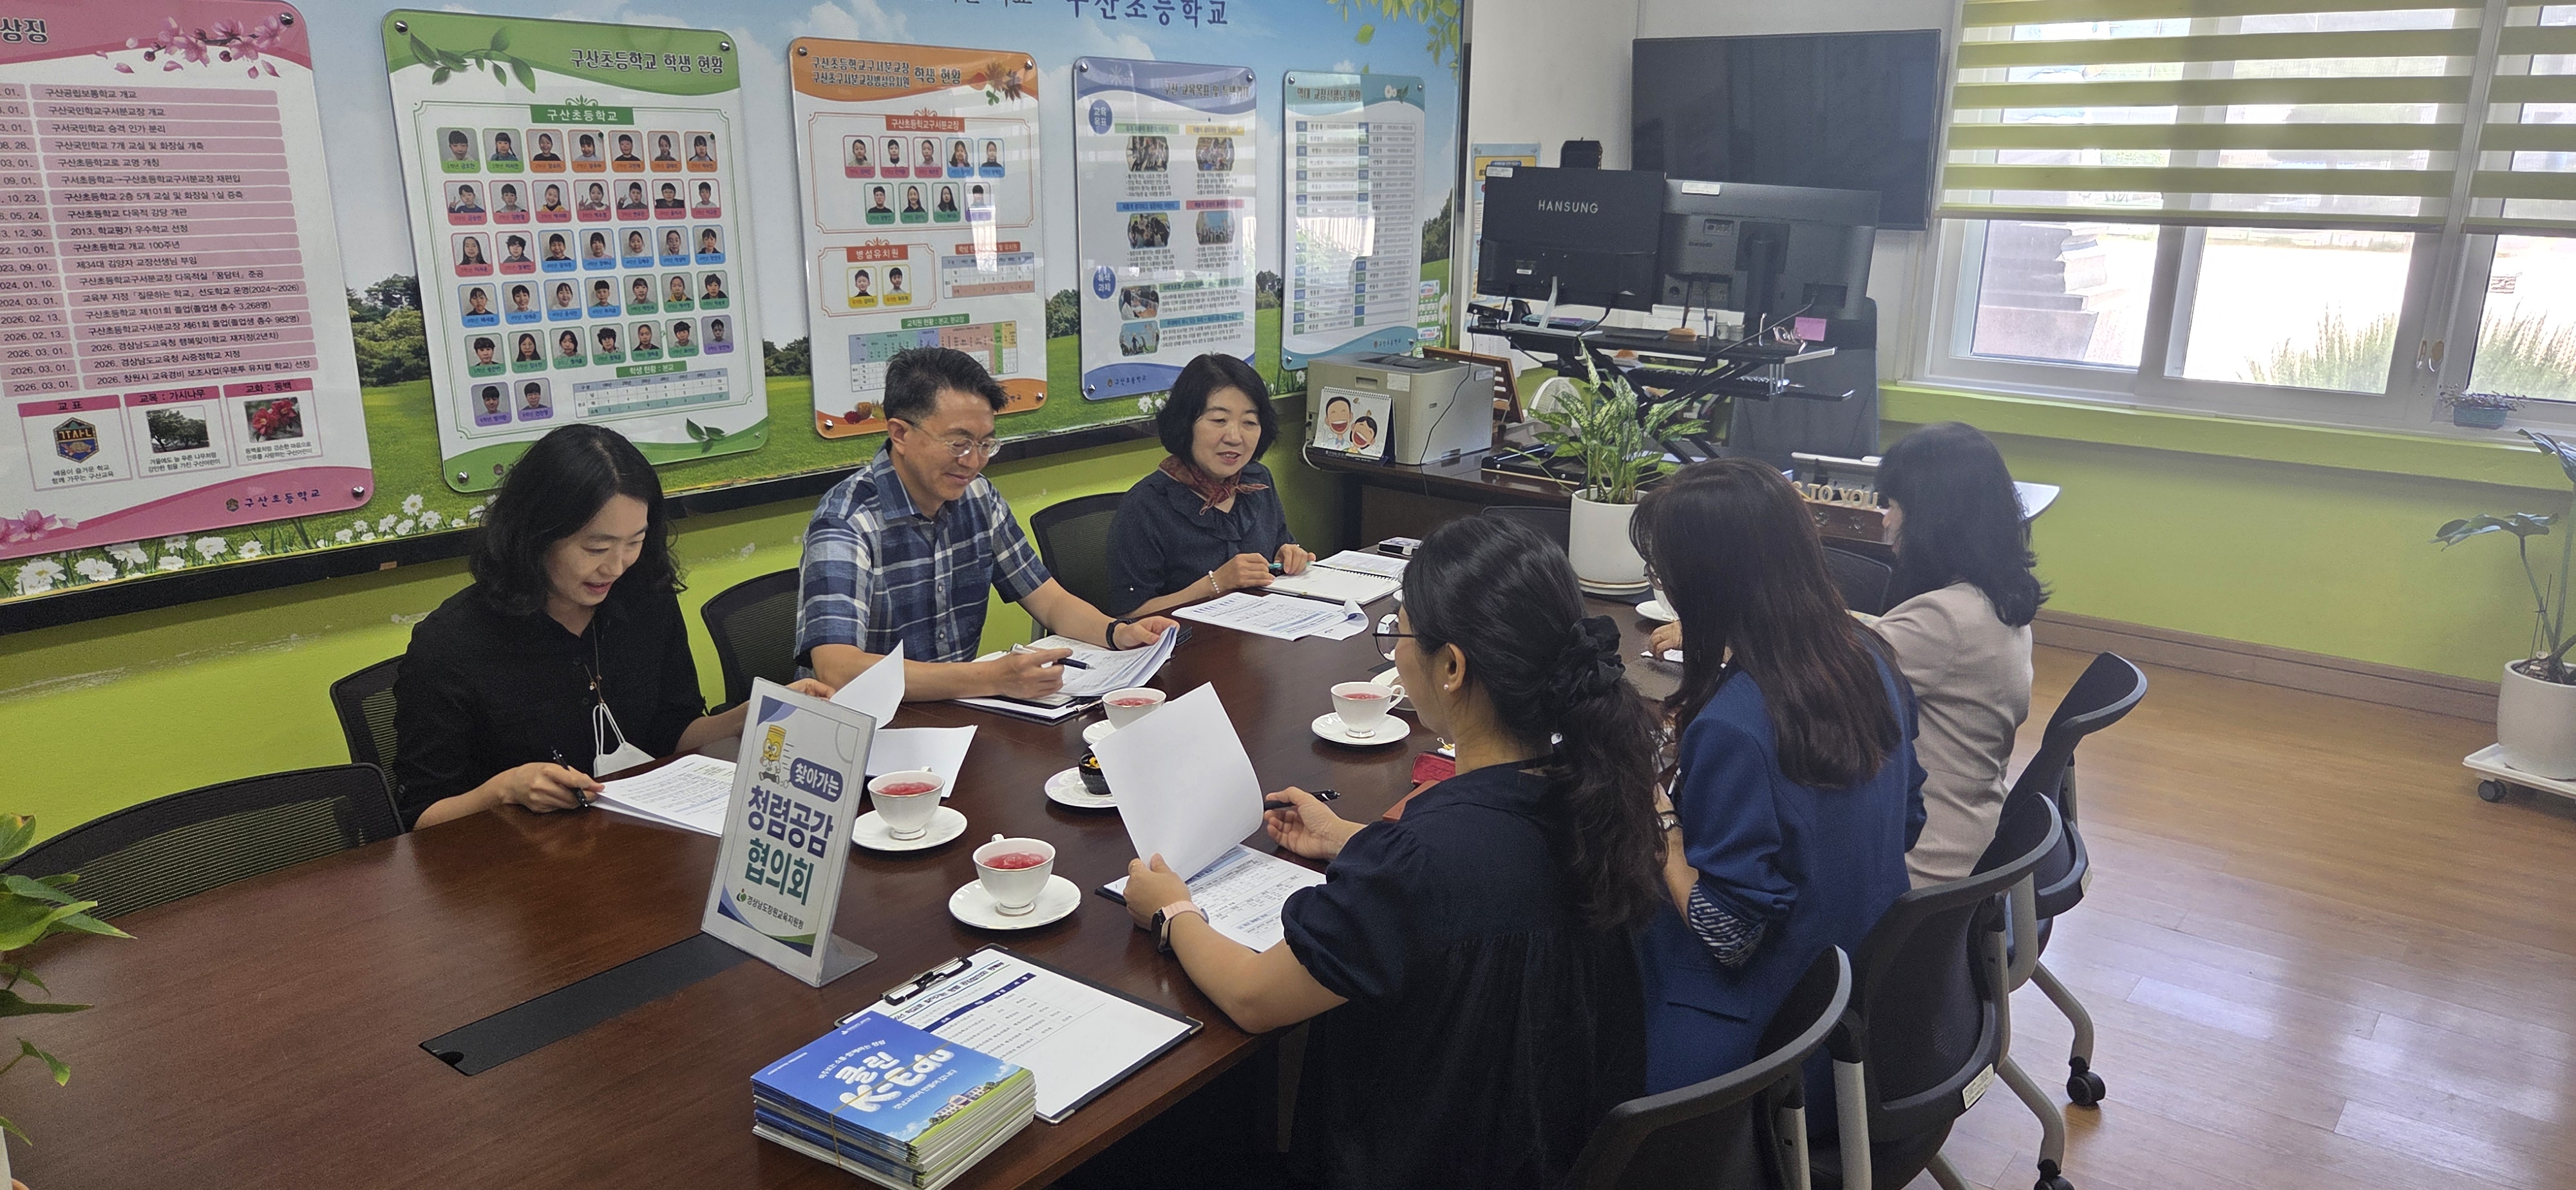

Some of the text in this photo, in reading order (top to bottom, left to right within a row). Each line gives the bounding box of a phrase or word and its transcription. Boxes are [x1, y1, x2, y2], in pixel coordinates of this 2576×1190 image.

[571, 50, 723, 74] 구산초등학교 학생 현황
[914, 67, 961, 84] 학생 현황
[120, 91, 137, 99] 개교
[547, 109, 618, 122] 구산초등학교
[108, 124, 126, 133] 승격
[128, 125, 146, 133] 인가
[149, 125, 166, 133] 분리
[15, 142, 30, 150] 28.
[111, 141, 125, 149] 7개
[160, 142, 184, 150] 화장실
[18, 159, 33, 167] 01.
[21, 176, 36, 185] 01.
[216, 175, 241, 183] 재편입
[8, 194, 22, 203] 10.
[24, 194, 39, 203] 23.
[64, 193, 117, 201] 구산초등학교
[153, 192, 170, 200] 교실
[184, 191, 209, 200] 화장실
[10, 212, 25, 220] 05.
[67, 210, 120, 219] 구산초등학교
[123, 209, 148, 217] 다목적
[171, 208, 187, 216] 개관
[1538, 200, 1598, 214] HANSUNG
[14, 229, 28, 238] 12.
[98, 226, 131, 236] 학교평가
[135, 225, 169, 234] 우수학교
[172, 225, 188, 233] 선정
[73, 243, 126, 252] 구산초등학교
[149, 240, 180, 249] 100주년
[856, 249, 899, 259] 병설유치원
[137, 256, 178, 267] 교장선생님
[180, 256, 197, 265] 부임
[41, 279, 55, 288] 10.
[175, 272, 207, 281] 다목적실
[249, 270, 263, 278] 준공
[82, 294, 108, 303] 교육부
[112, 293, 129, 301] 지정
[198, 287, 231, 296] 선도학교
[2, 316, 26, 324] 2026.
[84, 309, 137, 319] 구산초등학교
[140, 306, 171, 316] 제101회
[5, 332, 30, 341] 2026.
[50, 330, 64, 339] 13.
[88, 324, 180, 335] 구산초등학교구서분교장
[184, 321, 209, 330] 제61회
[7, 350, 33, 358] 2026.
[91, 344, 115, 352] 2026.
[118, 338, 176, 350] 경상남도교육청
[230, 331, 279, 343] 재지정(2년차)
[10, 367, 36, 375] 2026.
[94, 359, 118, 368] 2026.
[121, 353, 179, 366] 경상남도교육청
[182, 353, 222, 363] AI중점학교
[224, 350, 240, 359] 지정
[14, 384, 39, 392] 2026.
[41, 382, 56, 390] 03.
[97, 377, 122, 385] 2026.
[124, 373, 149, 382] 창원시
[152, 368, 184, 380] 교육경비
[249, 361, 272, 372] 뮤지컬
[274, 360, 292, 370] 학교)
[295, 360, 310, 369] 선정
[274, 382, 292, 391] 동백
[140, 390, 205, 402] 교목 가시나무
[244, 489, 321, 507] 구산초등학교
[1807, 483, 1879, 509] TO YOU
[795, 762, 839, 797] 찾아가는
[748, 784, 834, 859] 청렴공감
[744, 837, 815, 906] 협의회
[747, 895, 804, 930] 경상남도창원교육지원청
[835, 1051, 900, 1084] 클린
[839, 1048, 954, 1113] K-Edu
